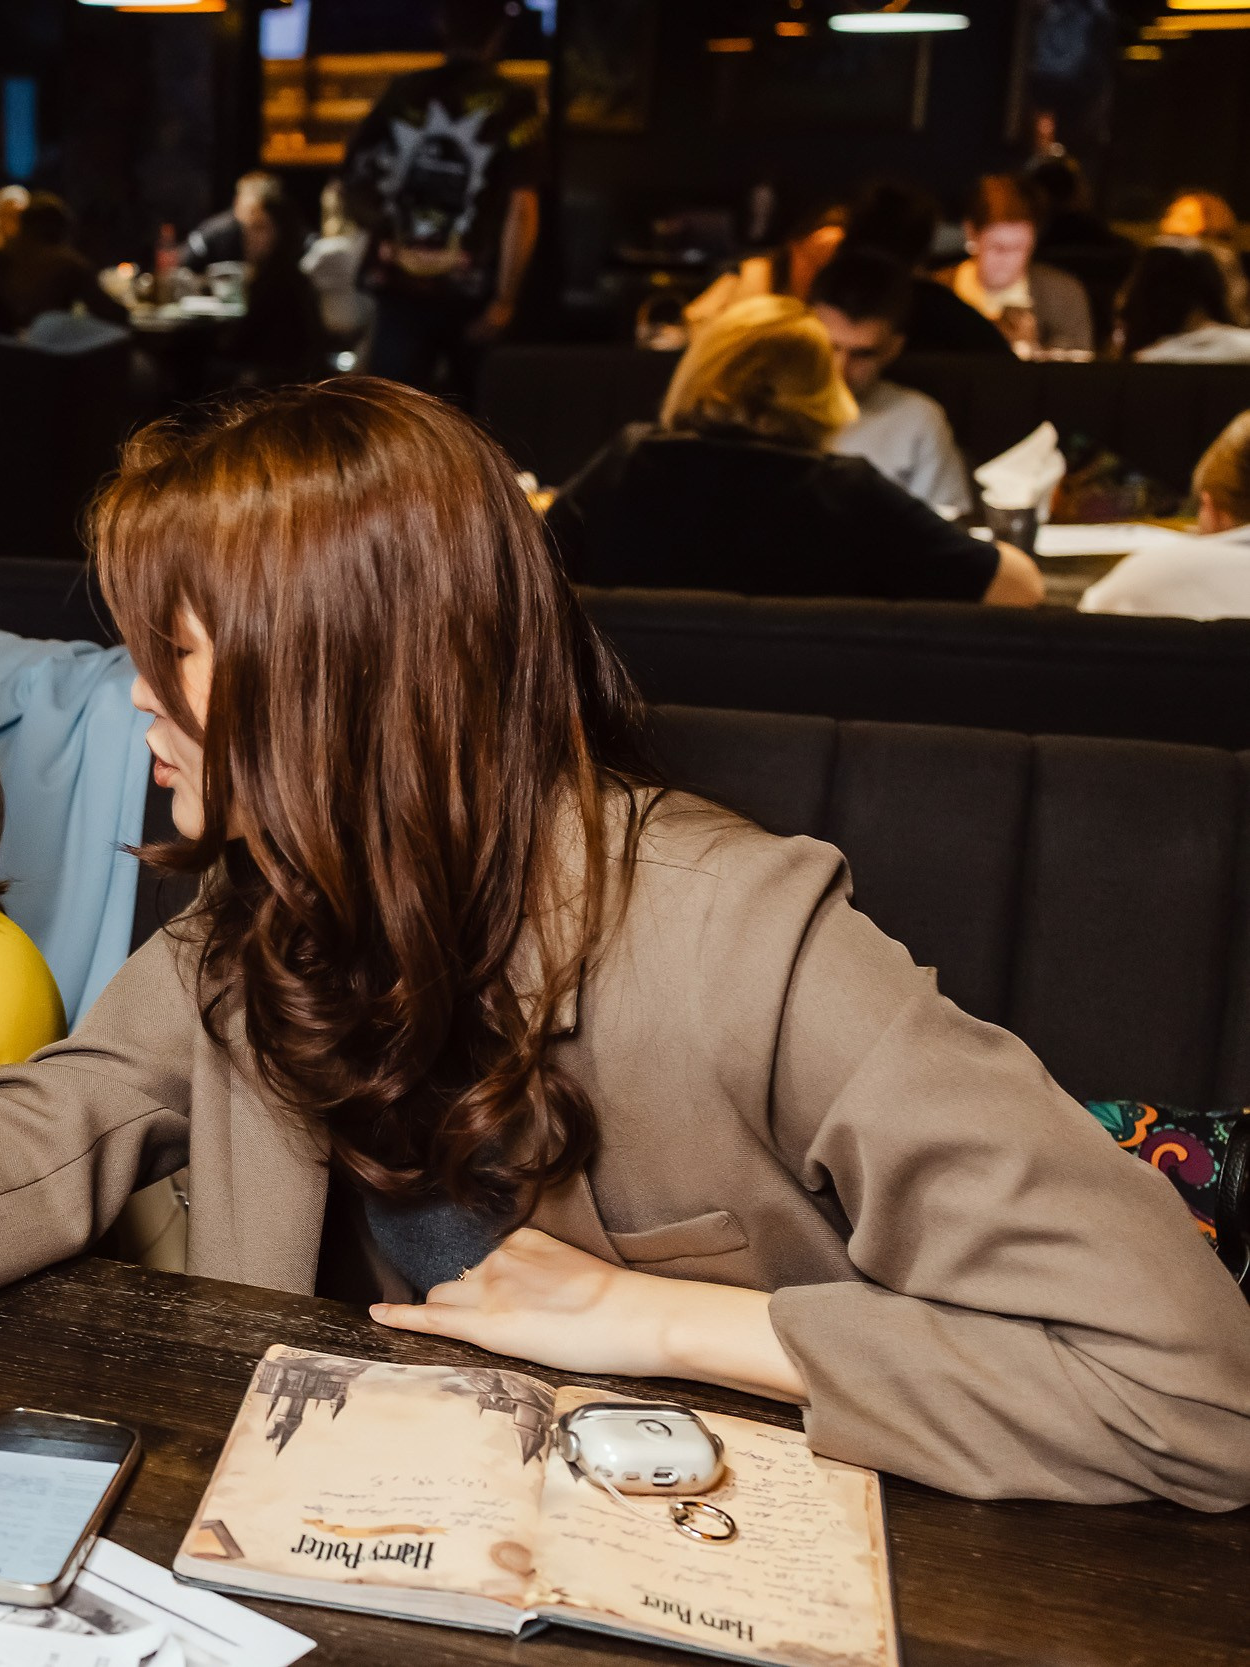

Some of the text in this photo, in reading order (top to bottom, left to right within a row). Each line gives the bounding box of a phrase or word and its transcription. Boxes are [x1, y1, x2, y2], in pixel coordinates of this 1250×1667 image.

[290, 1533, 435, 1571] Harry Potter
[695, 1610, 754, 1642] Harry
